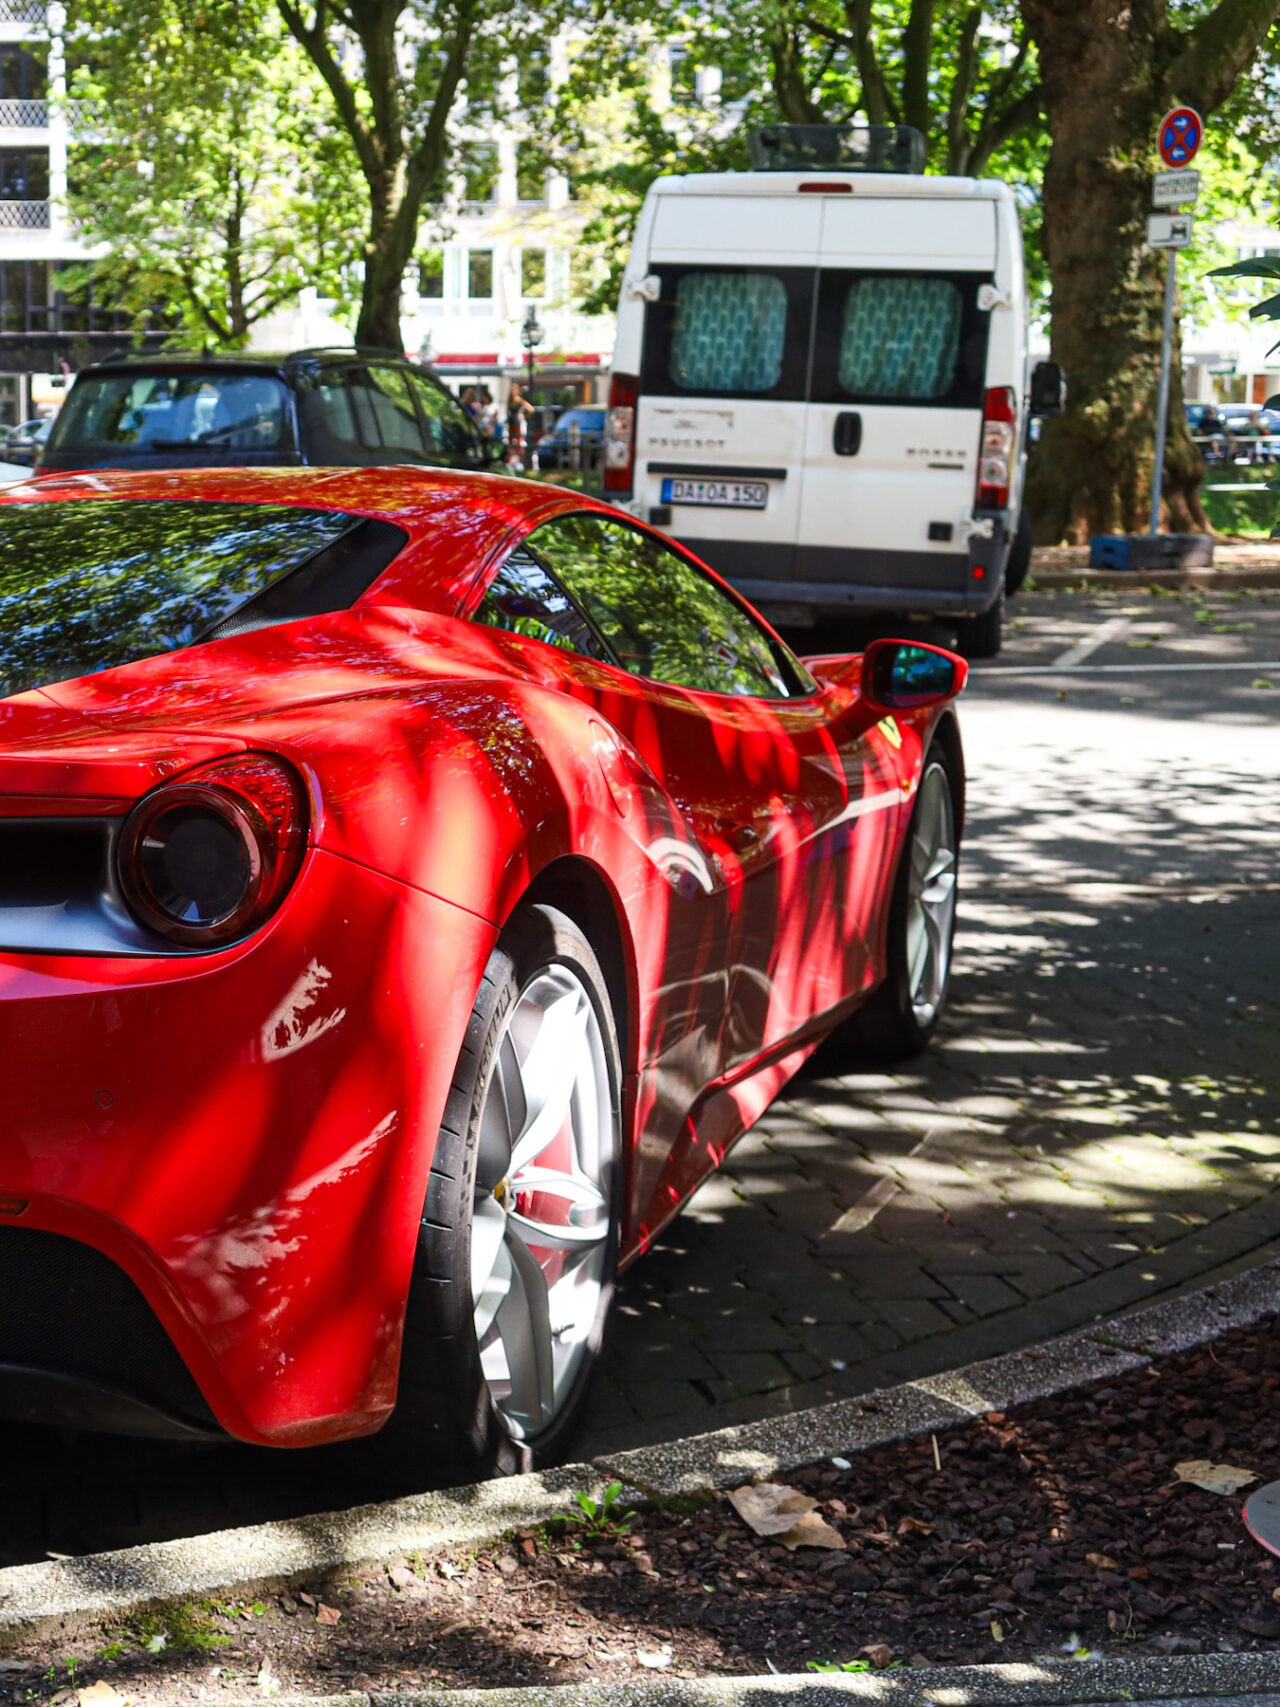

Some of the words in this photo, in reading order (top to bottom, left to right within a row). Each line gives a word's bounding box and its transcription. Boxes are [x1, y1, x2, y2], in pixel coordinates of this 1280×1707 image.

[674, 483, 694, 499] DA
[708, 485, 727, 501] OA
[732, 487, 765, 502] 150
